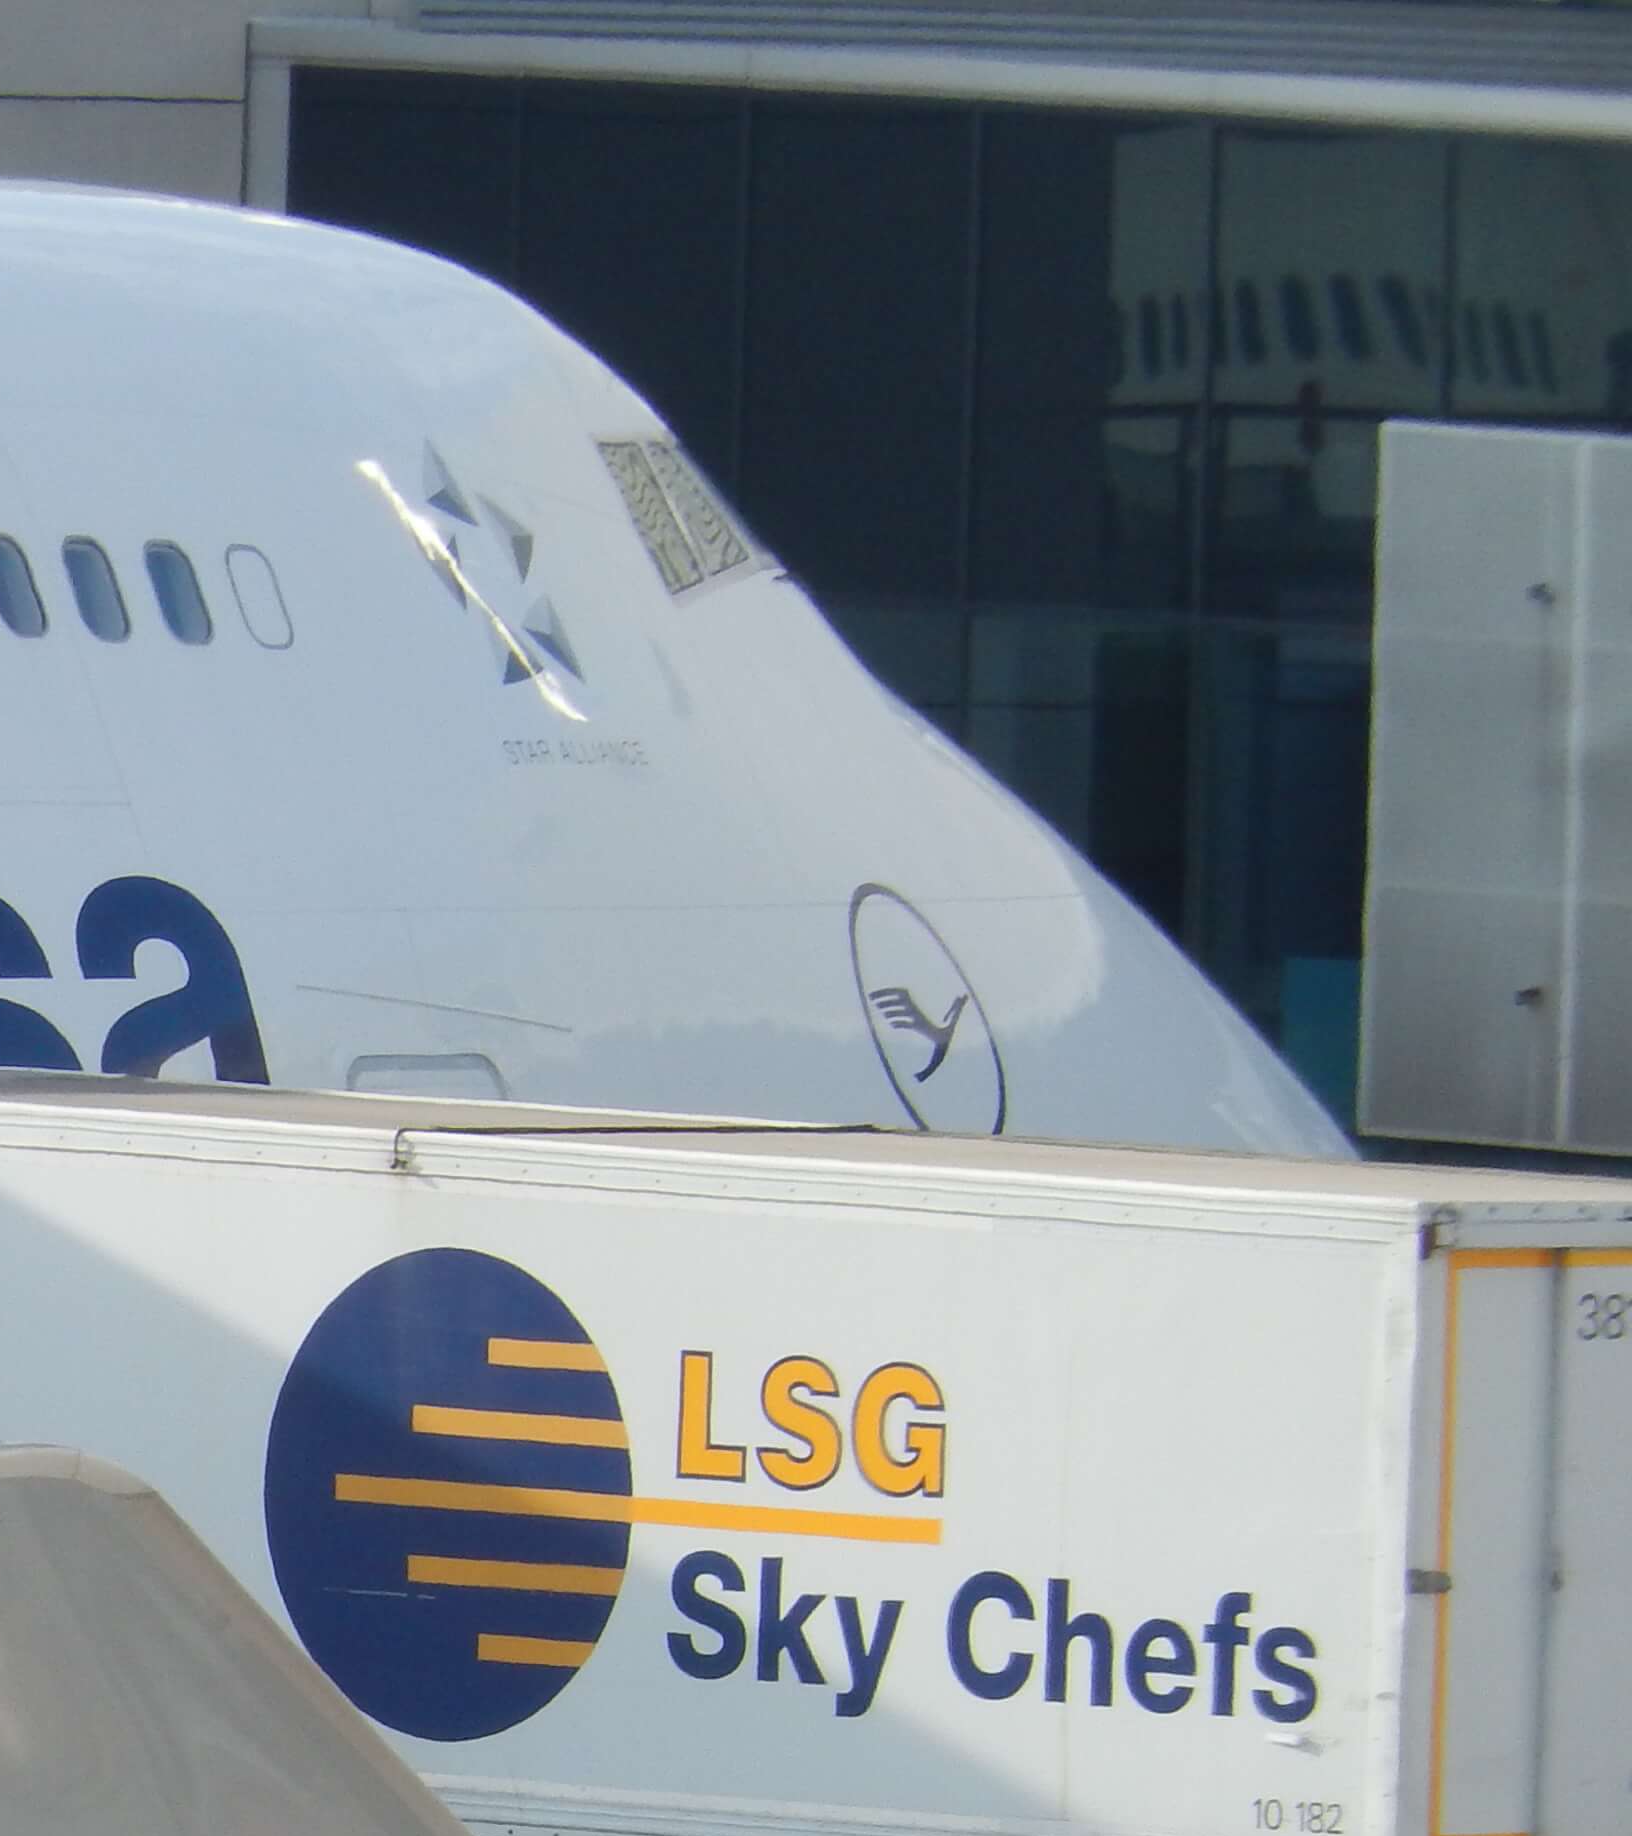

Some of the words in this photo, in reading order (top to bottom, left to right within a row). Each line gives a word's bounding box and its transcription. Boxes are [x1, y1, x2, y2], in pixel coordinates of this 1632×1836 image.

[674, 1349, 947, 1499] LSG
[666, 1550, 903, 1718] Sky
[946, 1570, 1320, 1726] Chefs
[1253, 1798, 1284, 1831] 10
[1295, 1801, 1344, 1835] 182
